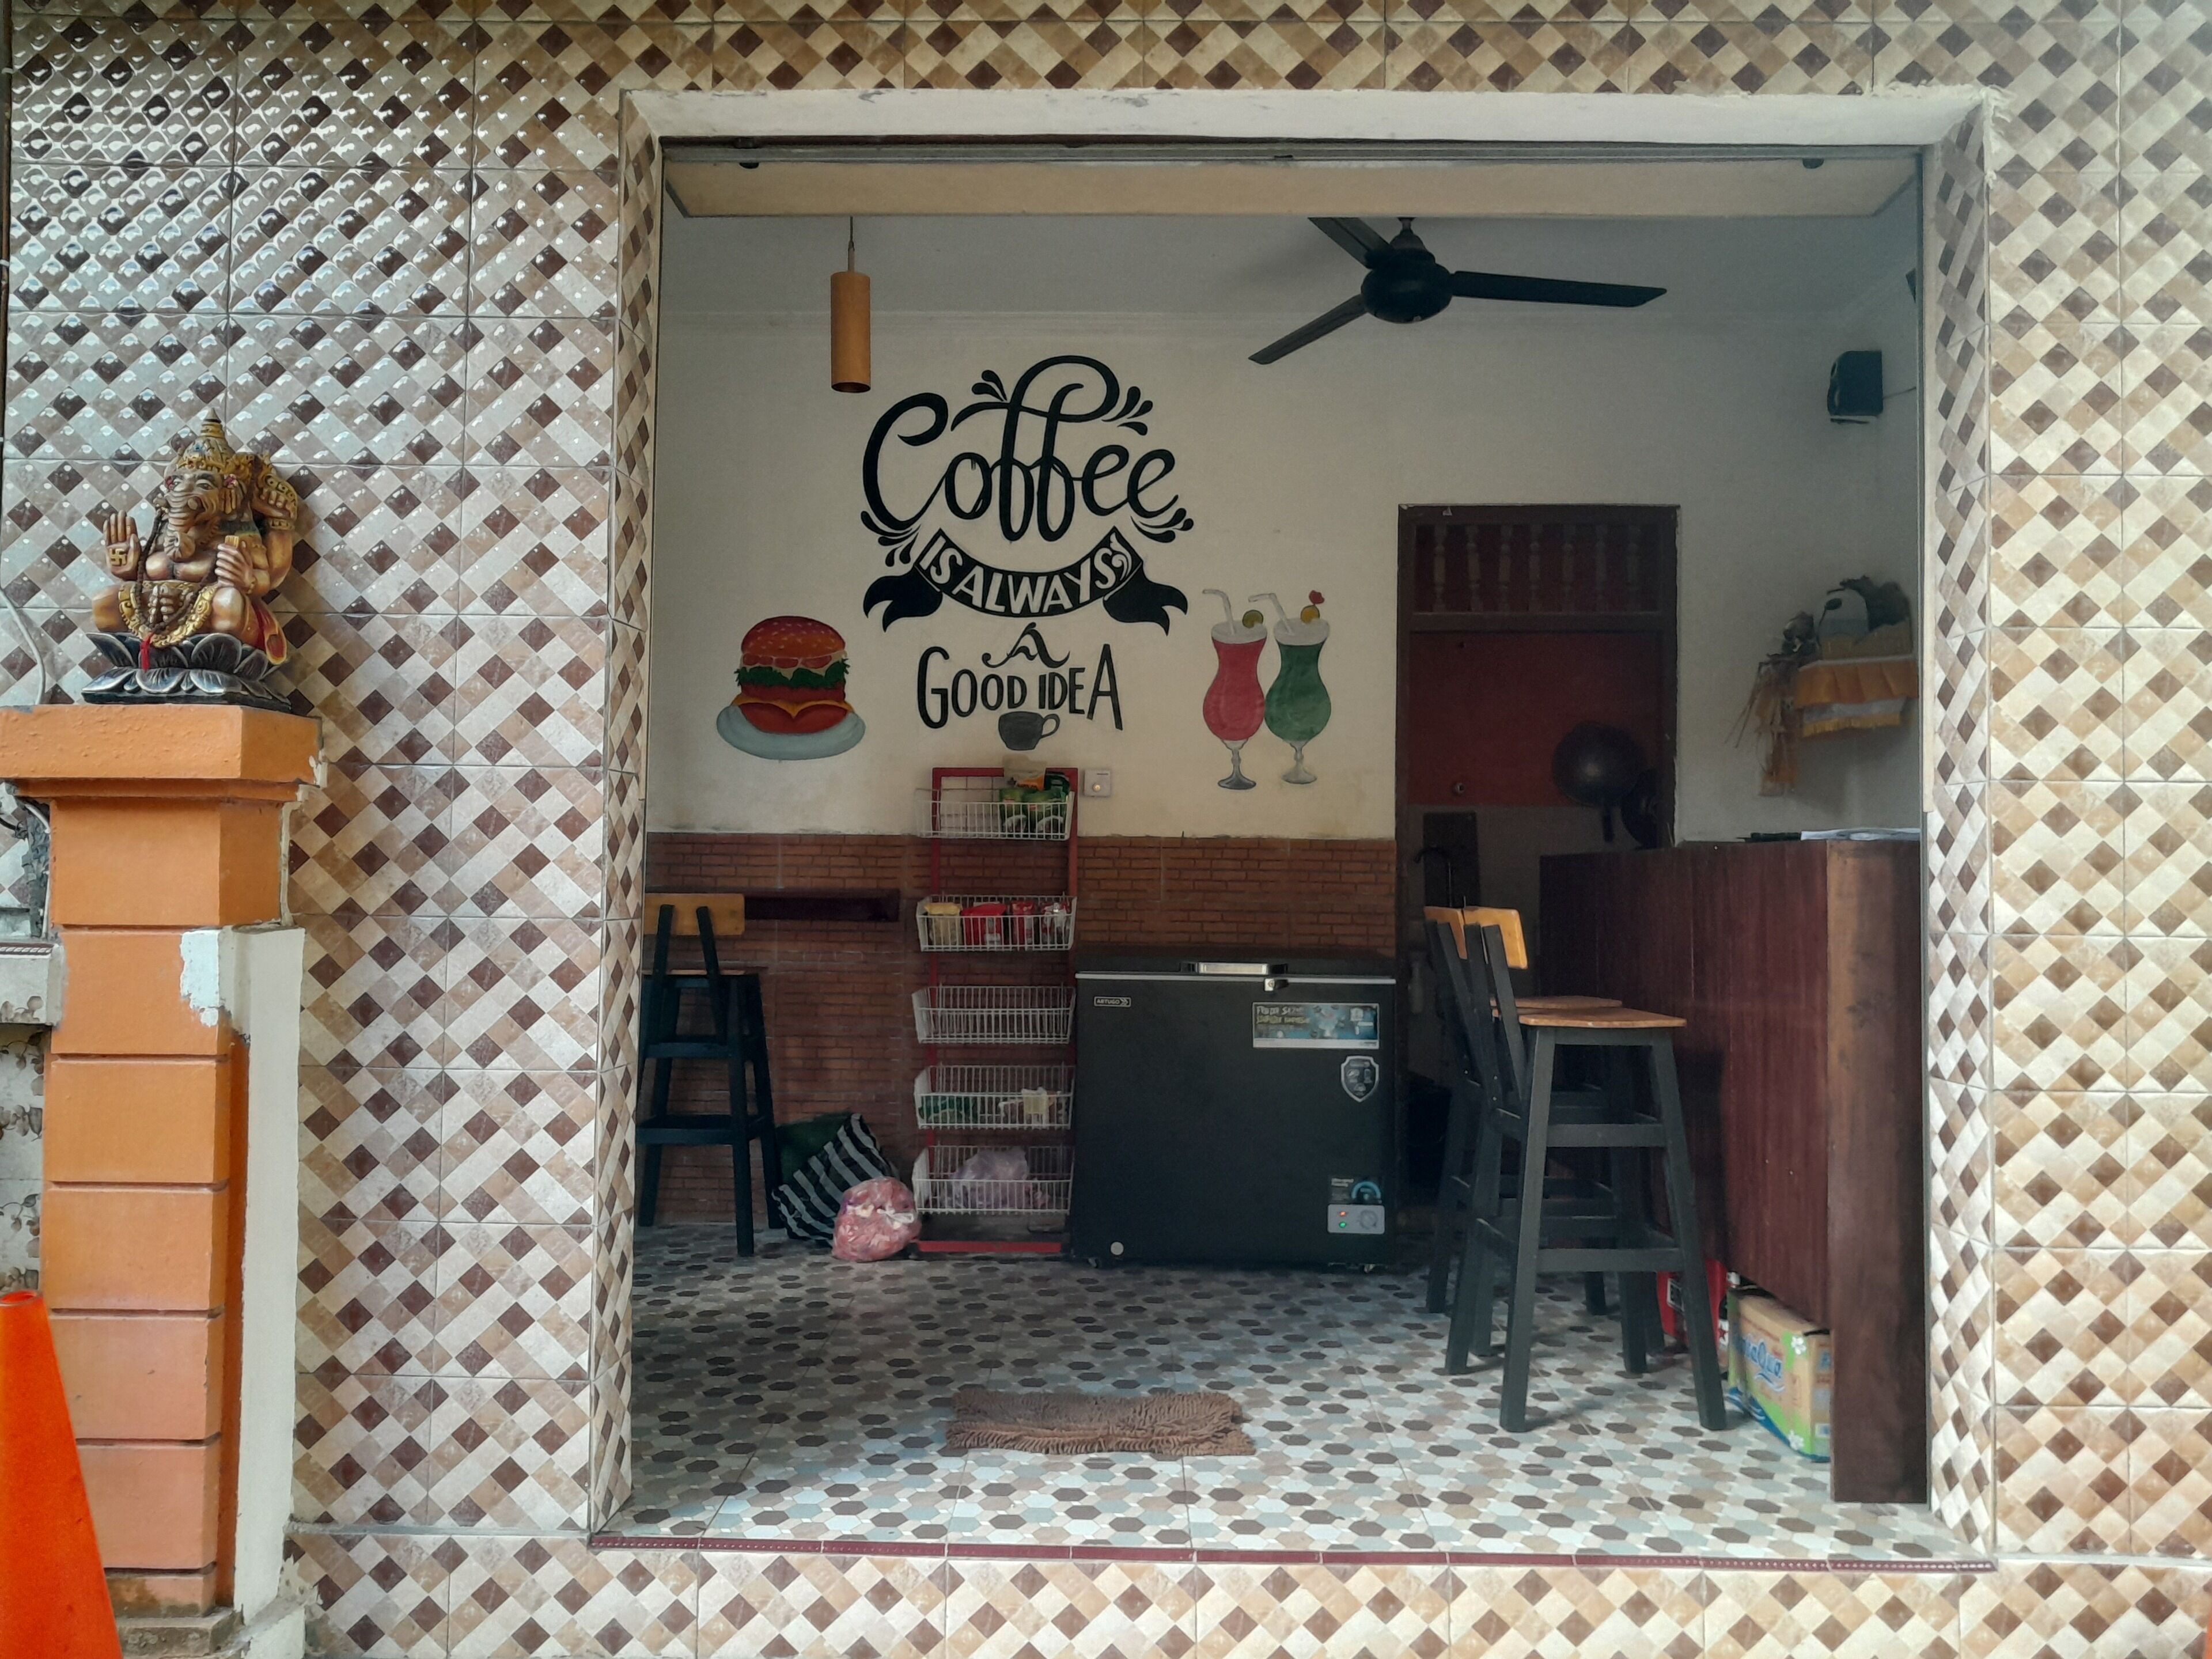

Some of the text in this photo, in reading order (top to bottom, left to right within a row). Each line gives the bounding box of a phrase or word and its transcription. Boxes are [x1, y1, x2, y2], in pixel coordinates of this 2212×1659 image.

[863, 355, 1179, 542] Coffee
[919, 535, 1116, 614] IS ALWAYS
[982, 622, 1070, 668] A
[917, 643, 1123, 731] GOOD IDEA
